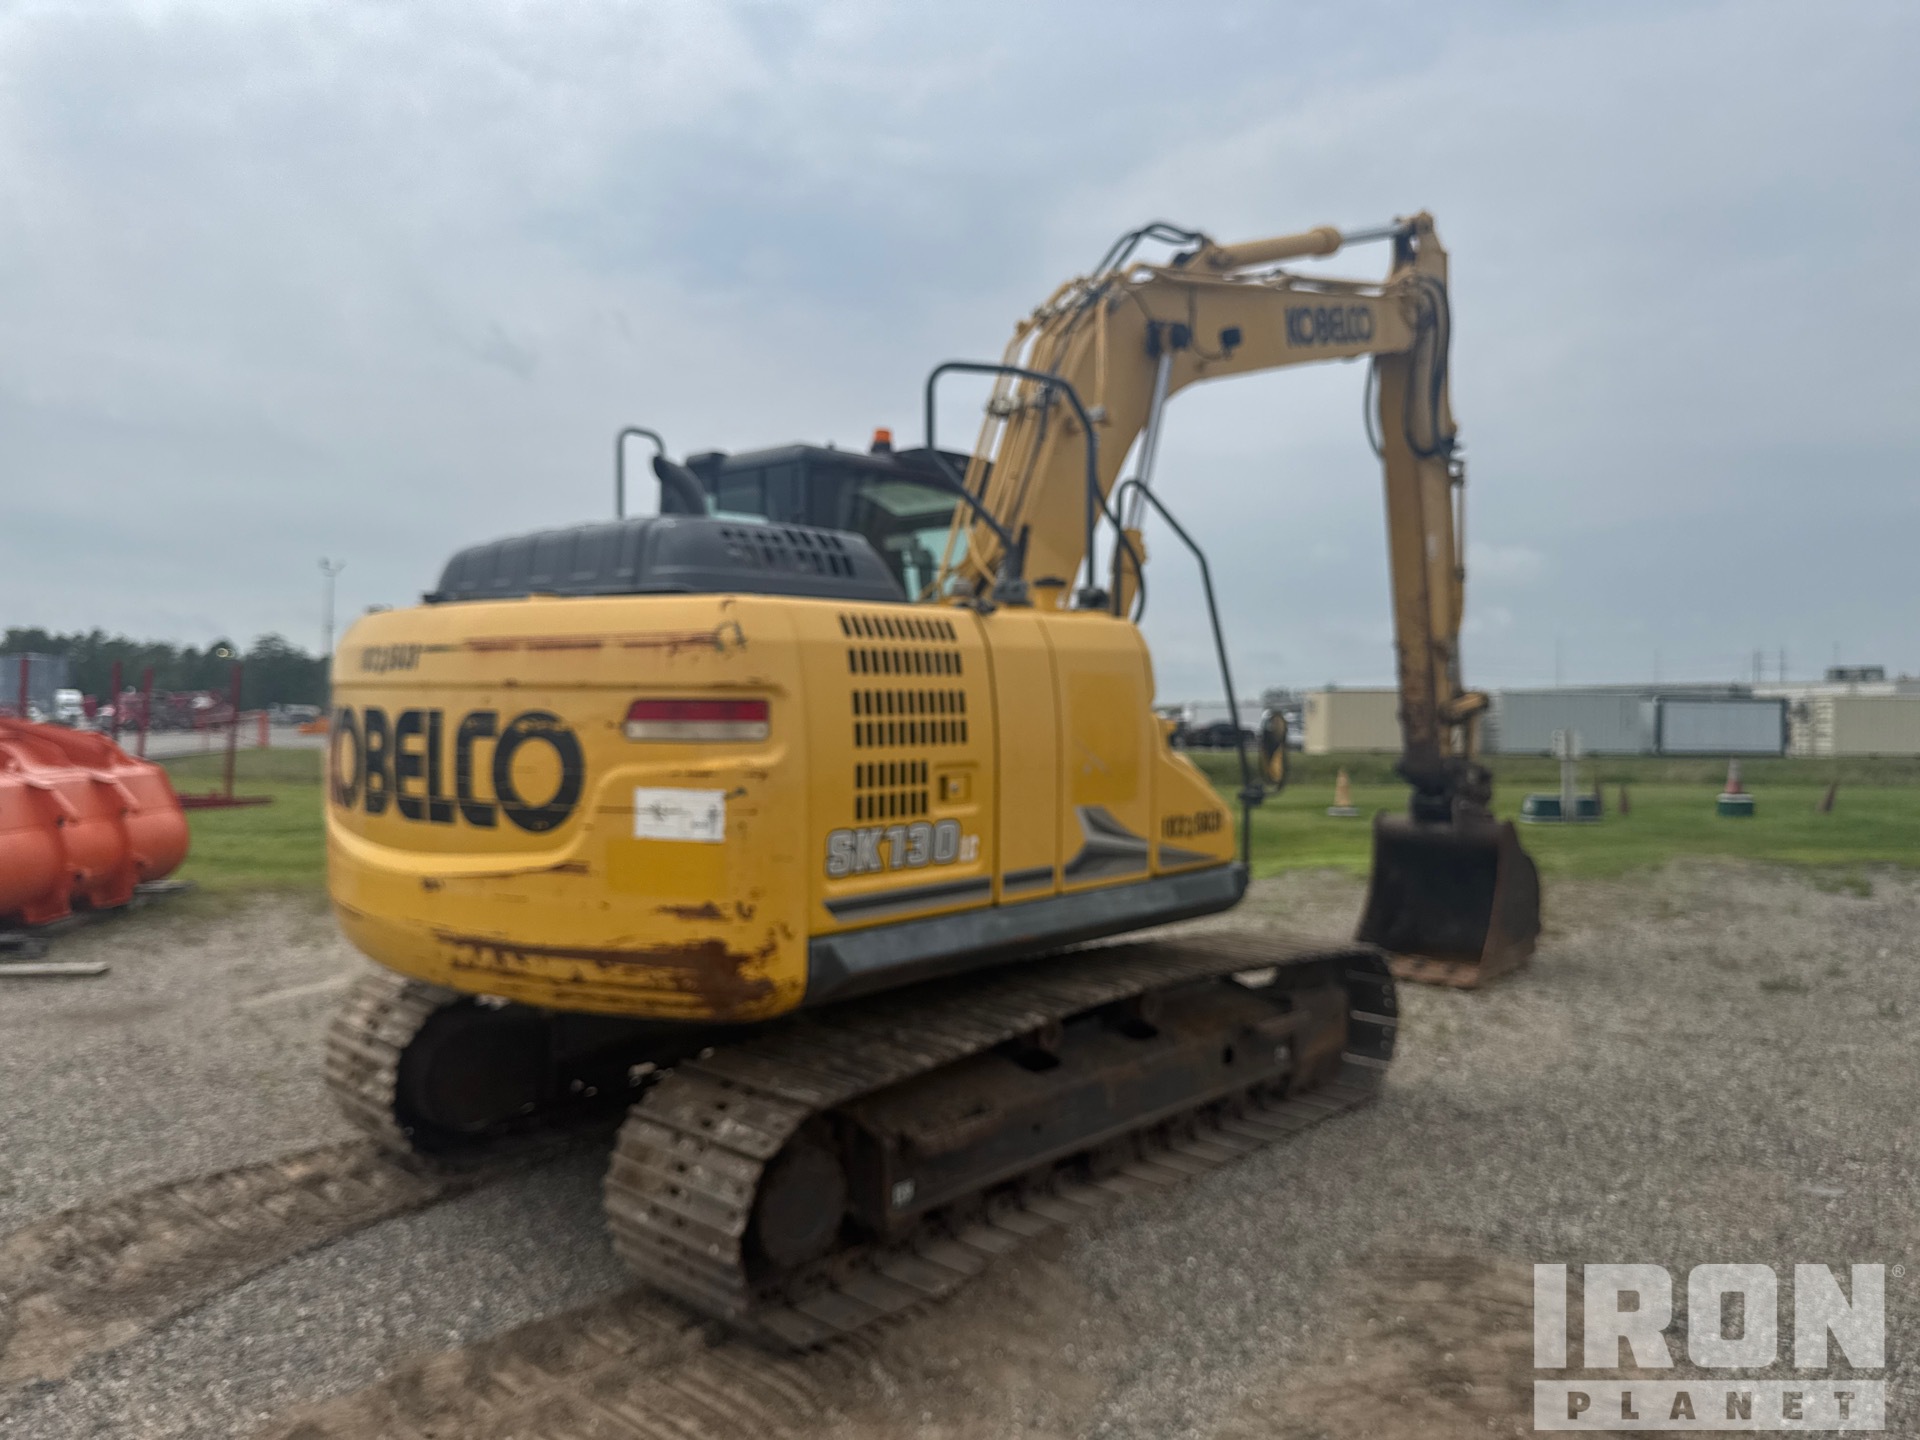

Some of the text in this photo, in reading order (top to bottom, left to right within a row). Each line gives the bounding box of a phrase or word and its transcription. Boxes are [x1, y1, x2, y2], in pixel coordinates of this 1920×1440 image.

[1285, 304, 1374, 347] KOBELCO
[331, 705, 584, 834] OBELCO
[825, 817, 962, 879] SK130
